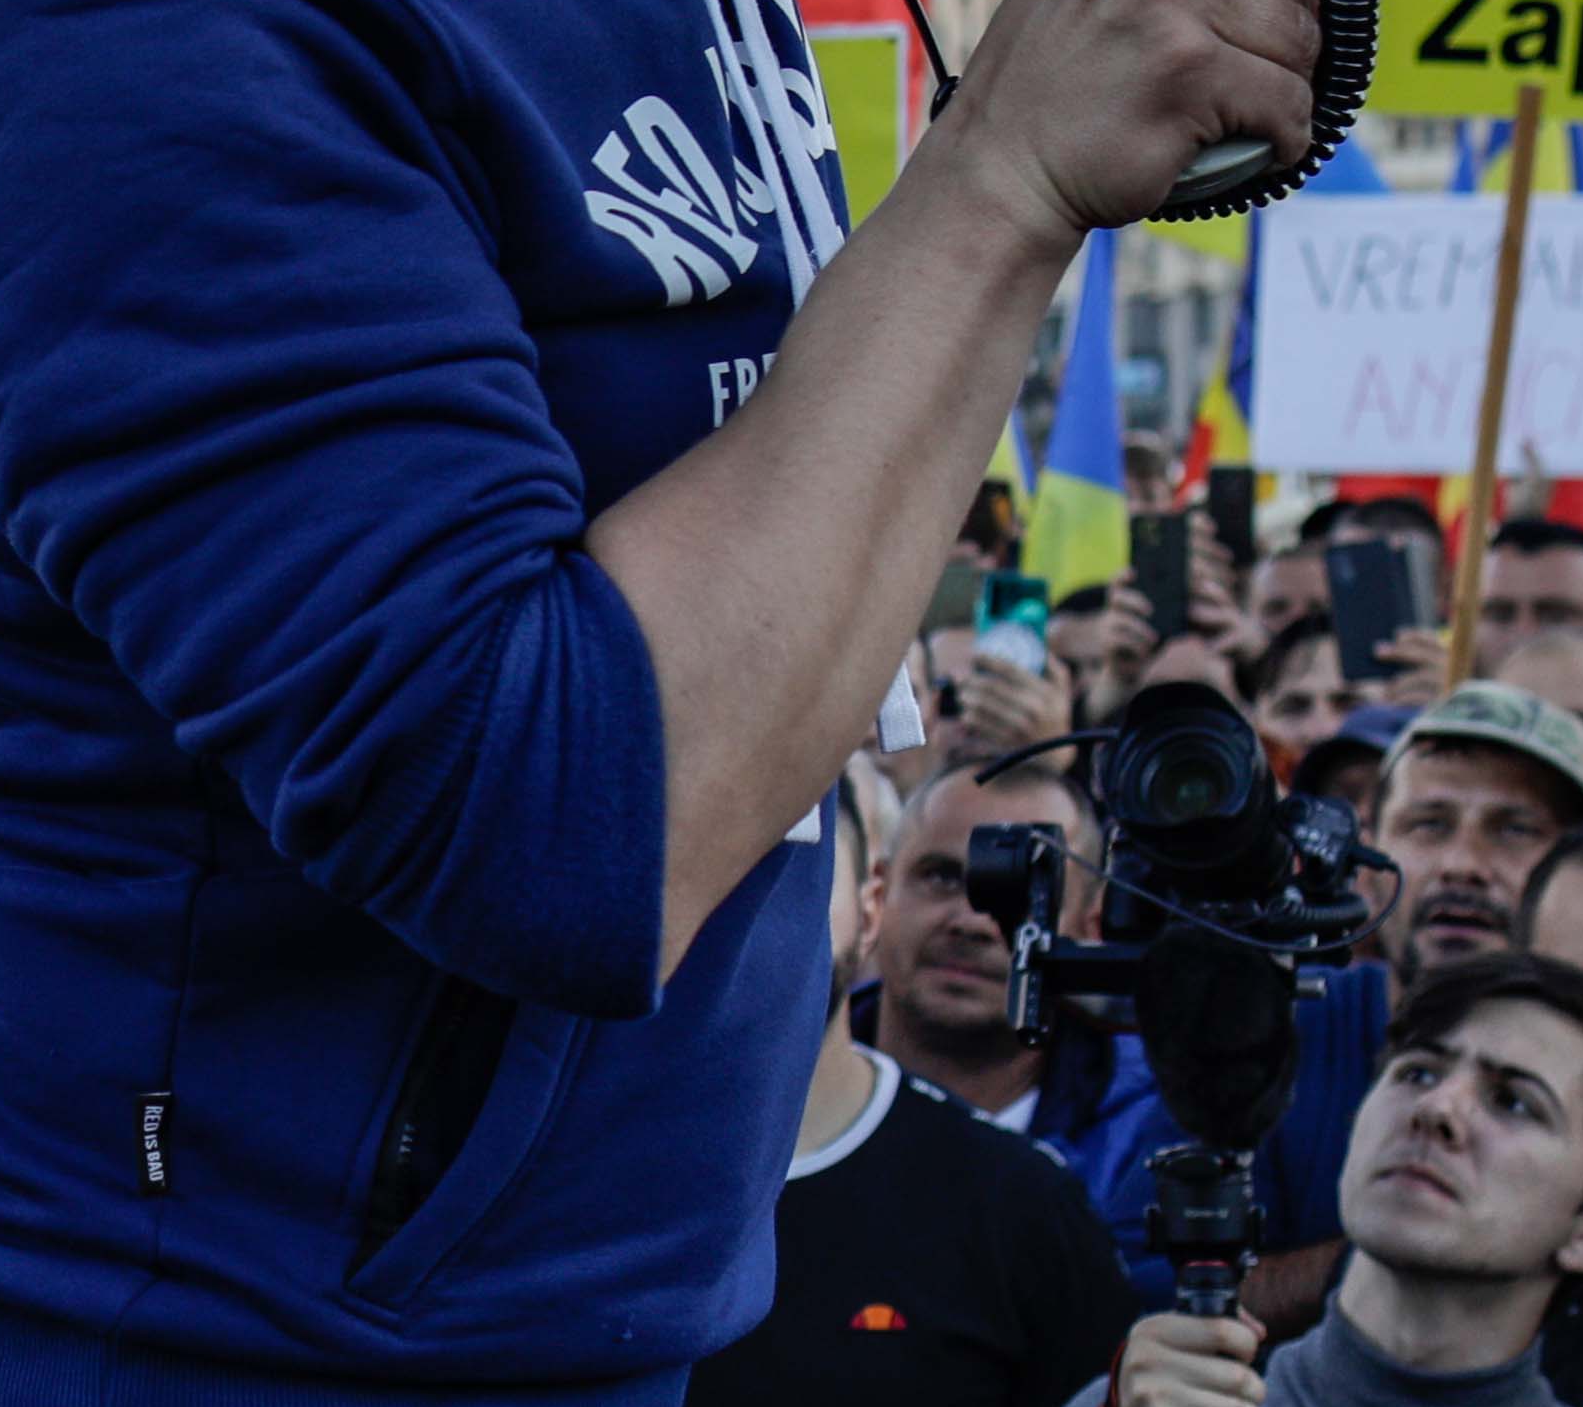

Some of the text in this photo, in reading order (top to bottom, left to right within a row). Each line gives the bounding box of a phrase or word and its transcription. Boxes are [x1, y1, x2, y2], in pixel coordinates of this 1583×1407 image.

[143, 1105, 165, 1182] RED IS BAD
